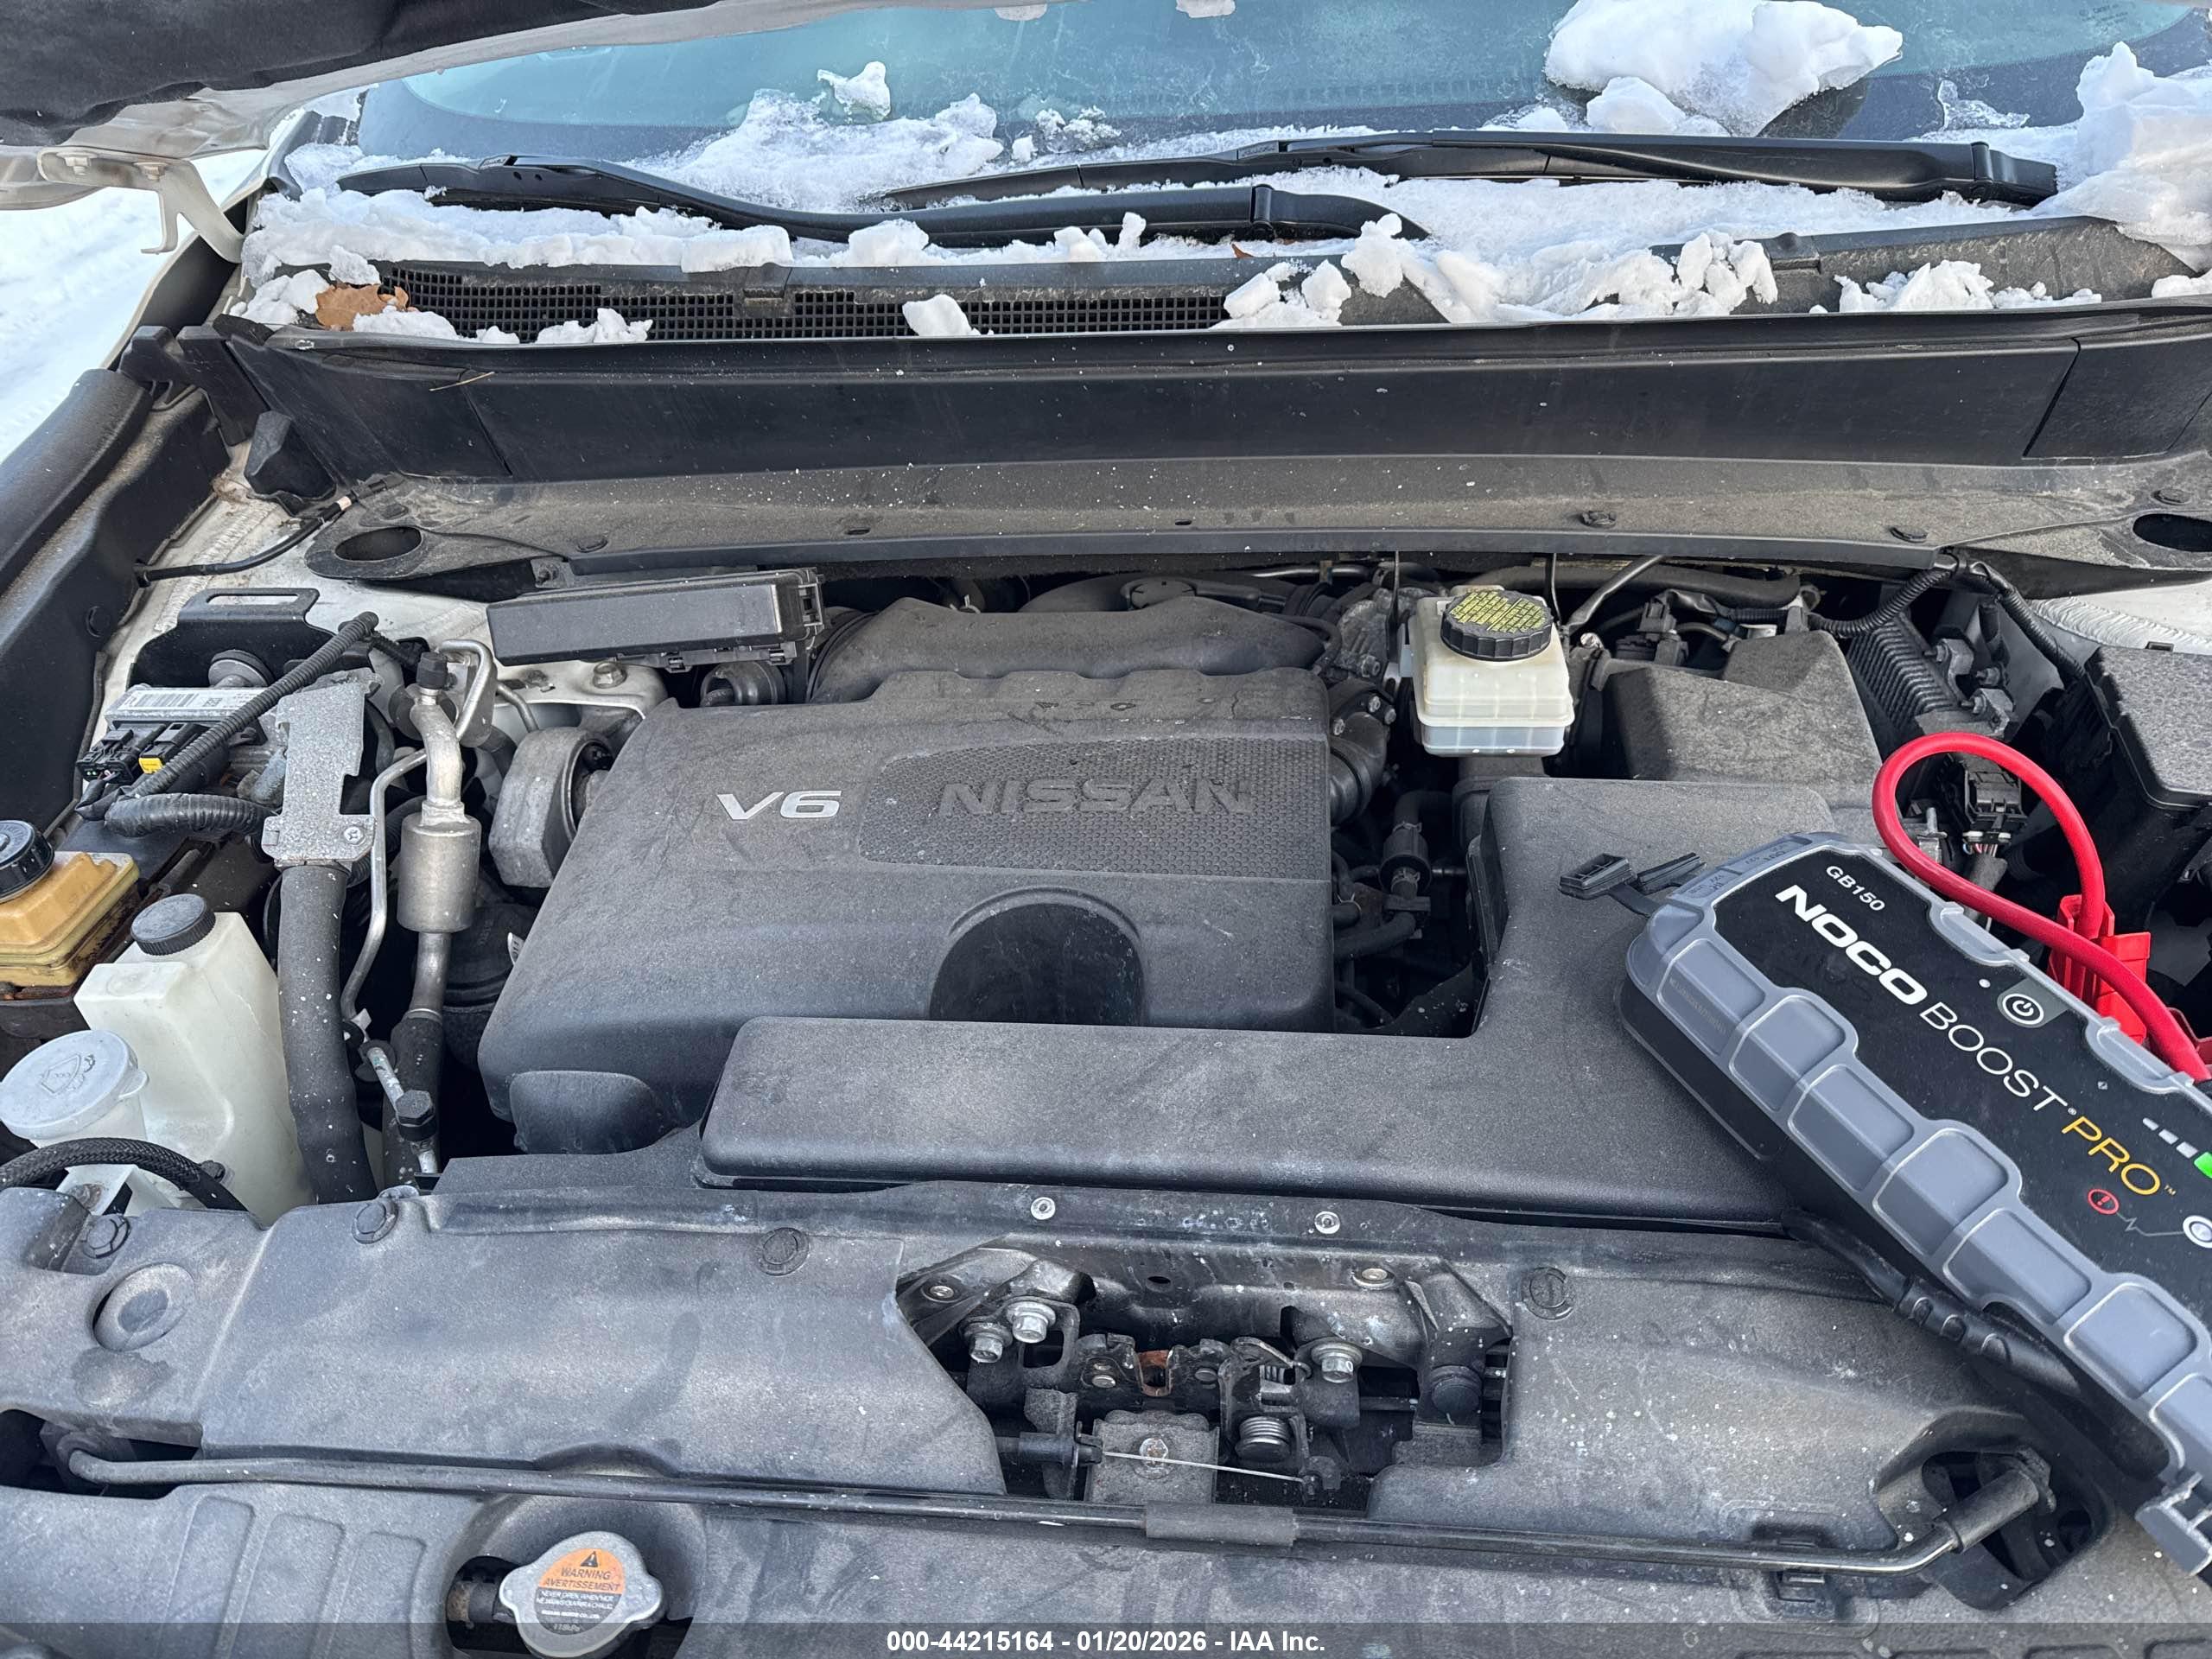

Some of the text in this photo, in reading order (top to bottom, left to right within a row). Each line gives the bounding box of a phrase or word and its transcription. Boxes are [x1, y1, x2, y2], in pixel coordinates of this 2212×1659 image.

[716, 790, 842, 820] V6
[938, 777, 1255, 816] NISSAN
[1826, 866, 1886, 912] GB150
[1775, 884, 1929, 1006] NOCO
[545, 1578, 621, 1592] AVERTISSEMENT
[561, 1567, 612, 1580] WARNING
